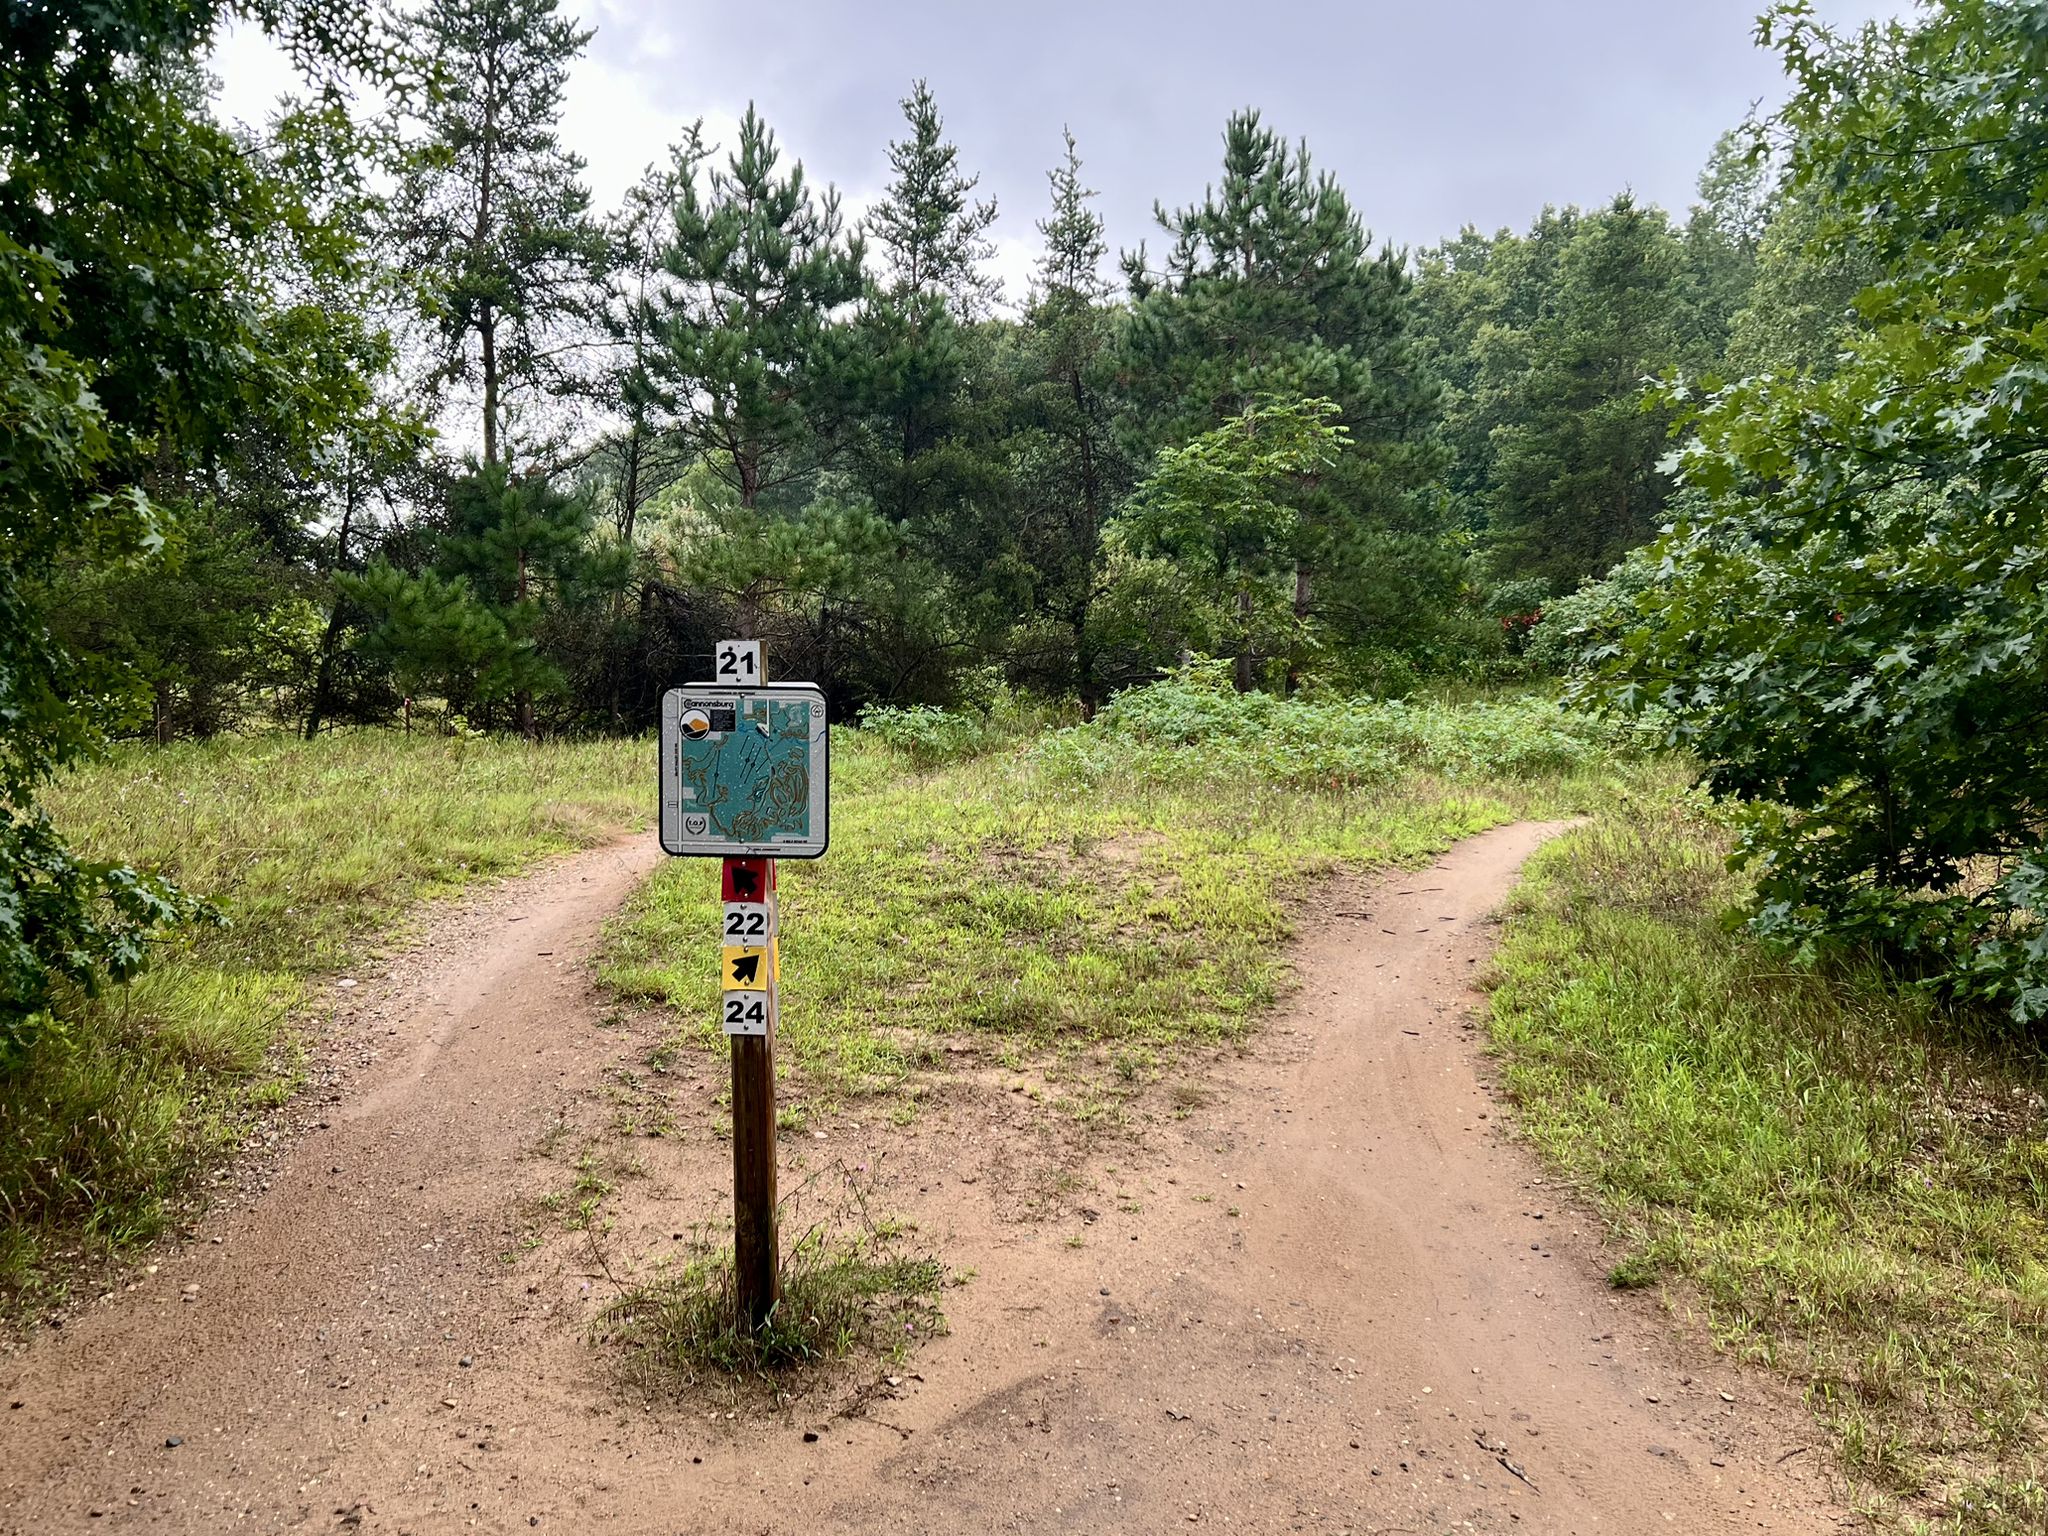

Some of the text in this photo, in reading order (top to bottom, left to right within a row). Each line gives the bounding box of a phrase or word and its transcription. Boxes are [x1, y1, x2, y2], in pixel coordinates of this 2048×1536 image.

[719, 651, 754, 675] 21
[684, 699, 734, 710] Cannonsburg
[726, 912, 765, 936] 22
[725, 1000, 765, 1025] 24
